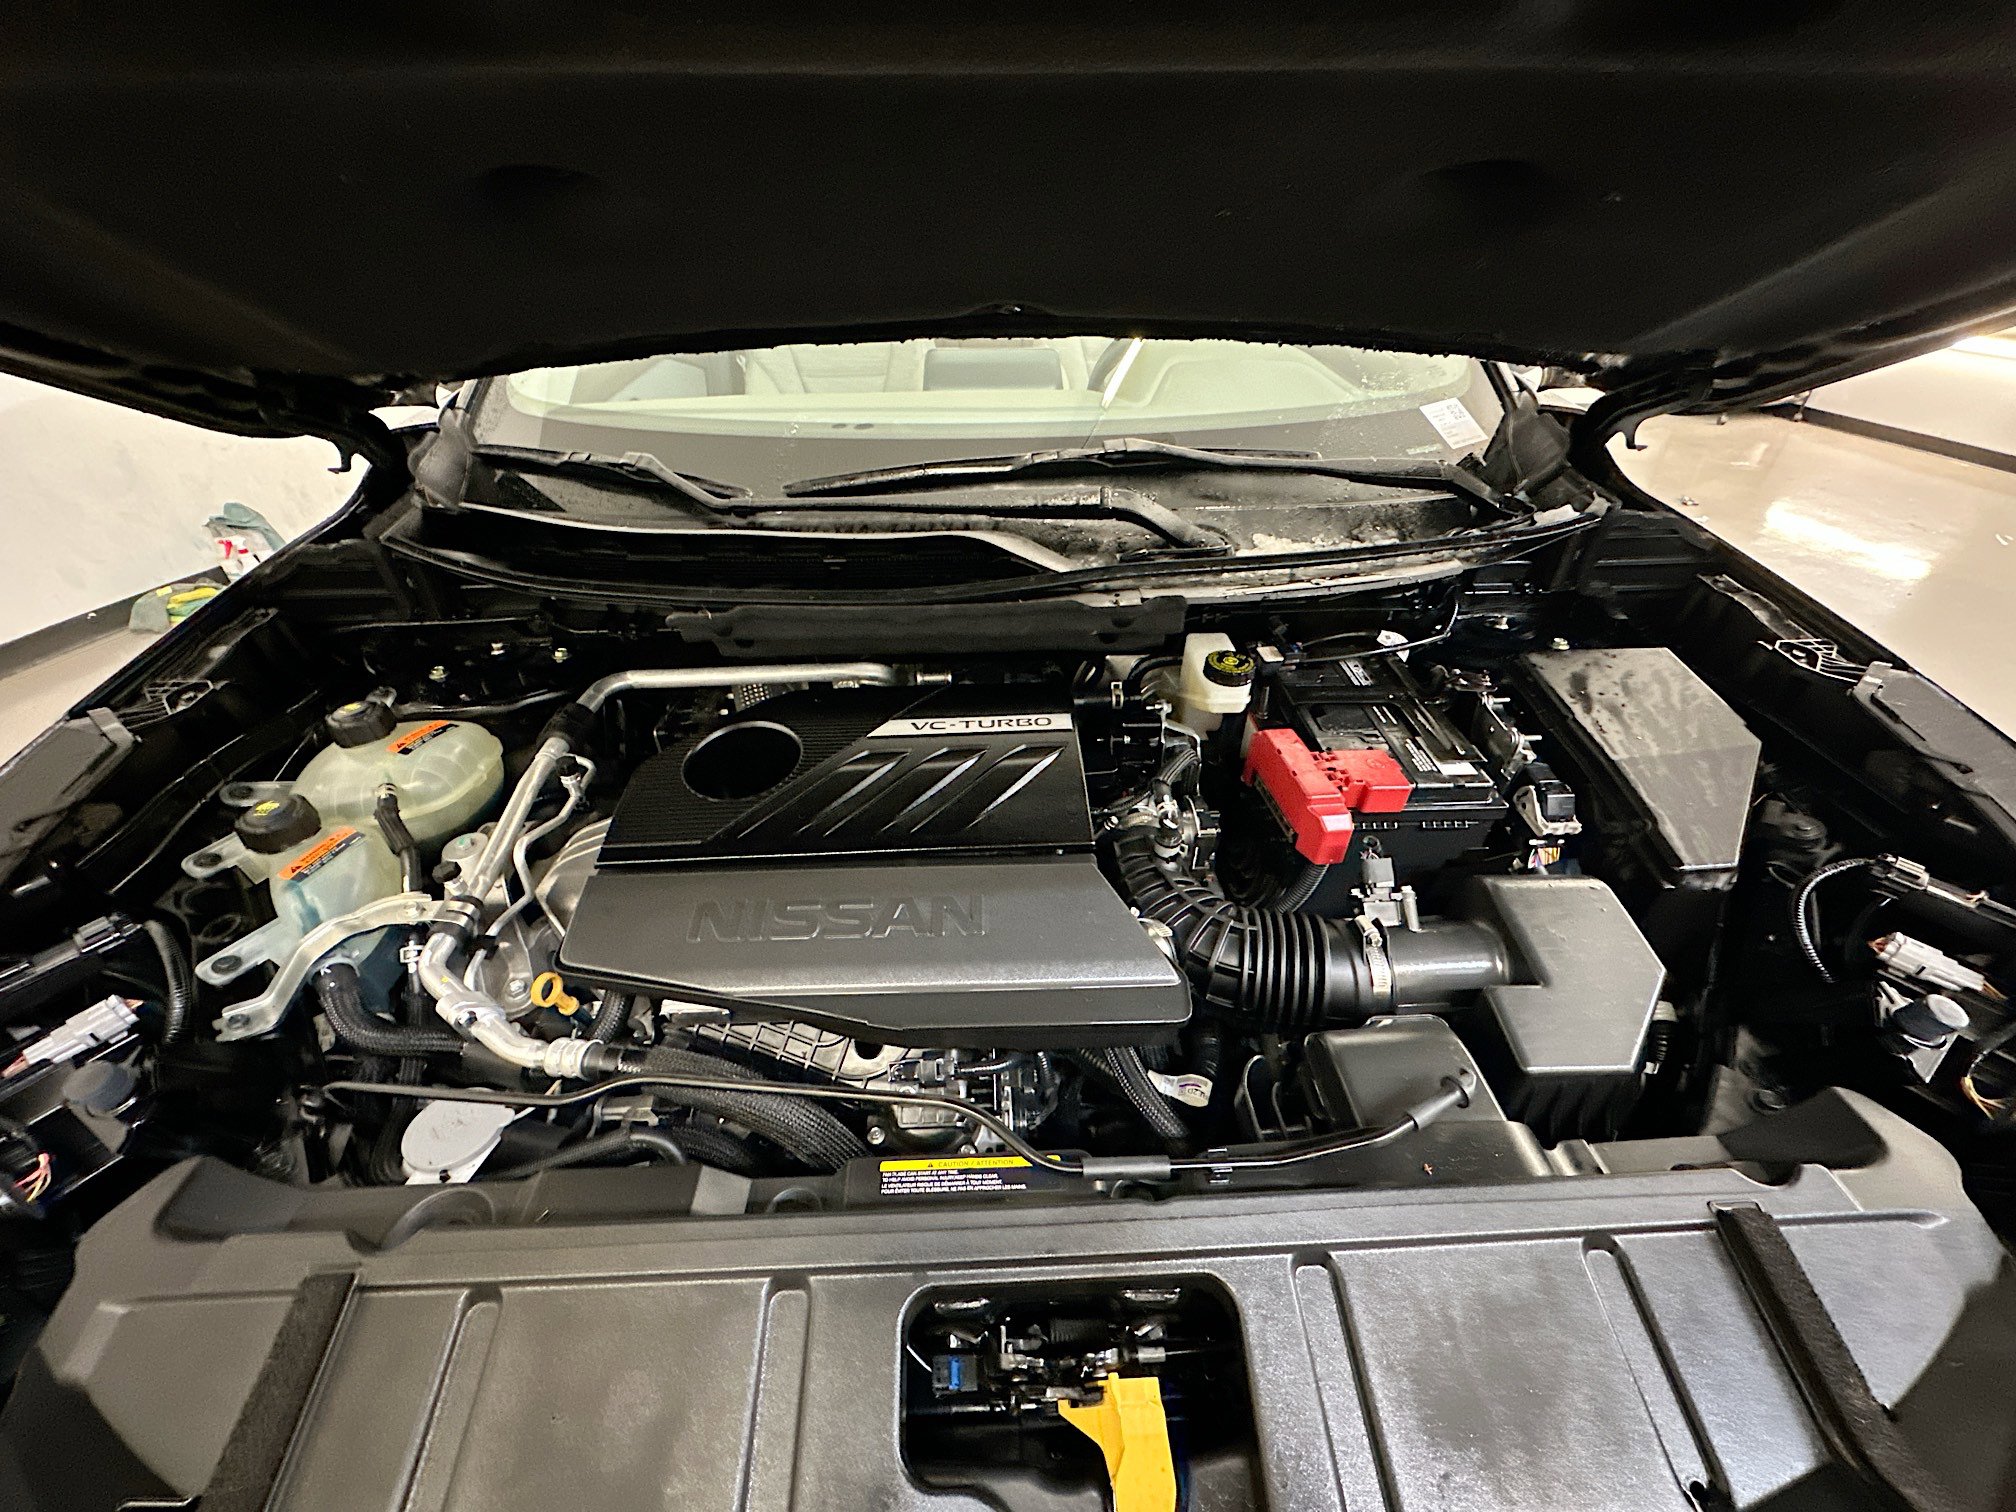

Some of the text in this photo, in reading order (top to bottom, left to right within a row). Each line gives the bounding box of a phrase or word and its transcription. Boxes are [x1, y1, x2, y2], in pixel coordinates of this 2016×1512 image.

[910, 717, 1052, 731] VC-TURBO
[686, 896, 987, 944] NISSAN
[938, 1160, 969, 1168] CAUTION
